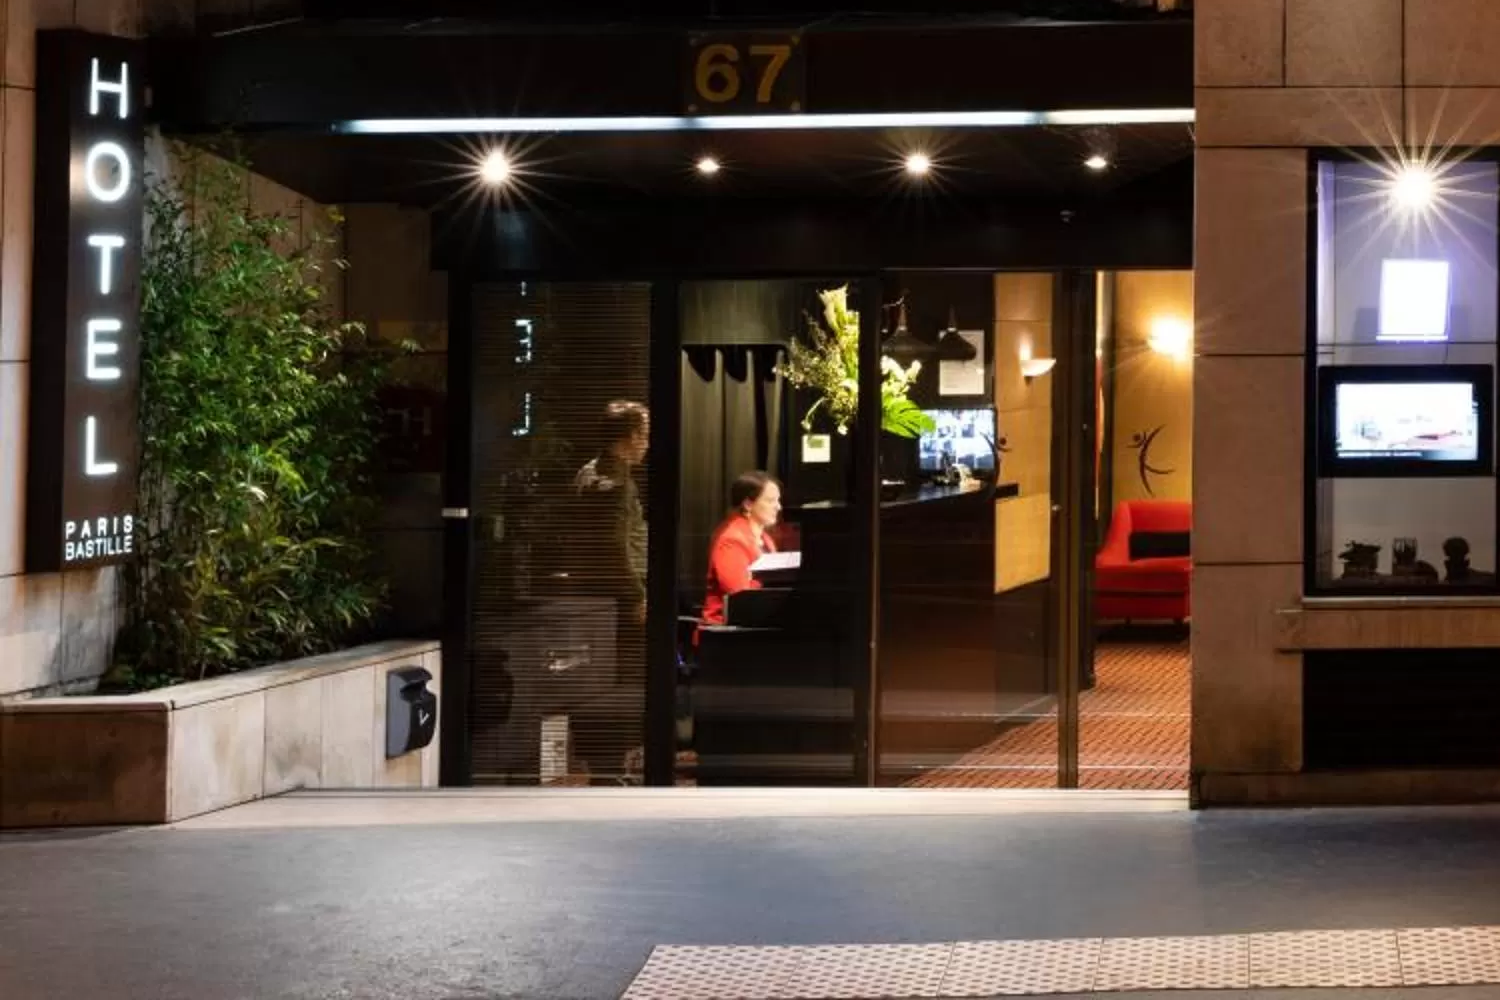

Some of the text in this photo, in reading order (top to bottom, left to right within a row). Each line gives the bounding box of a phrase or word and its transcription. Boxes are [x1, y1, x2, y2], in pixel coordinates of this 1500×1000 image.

[697, 44, 791, 103] 67
[84, 57, 132, 477] HOTEL
[65, 514, 133, 539] PARIS
[65, 535, 132, 561] BASTILLE
